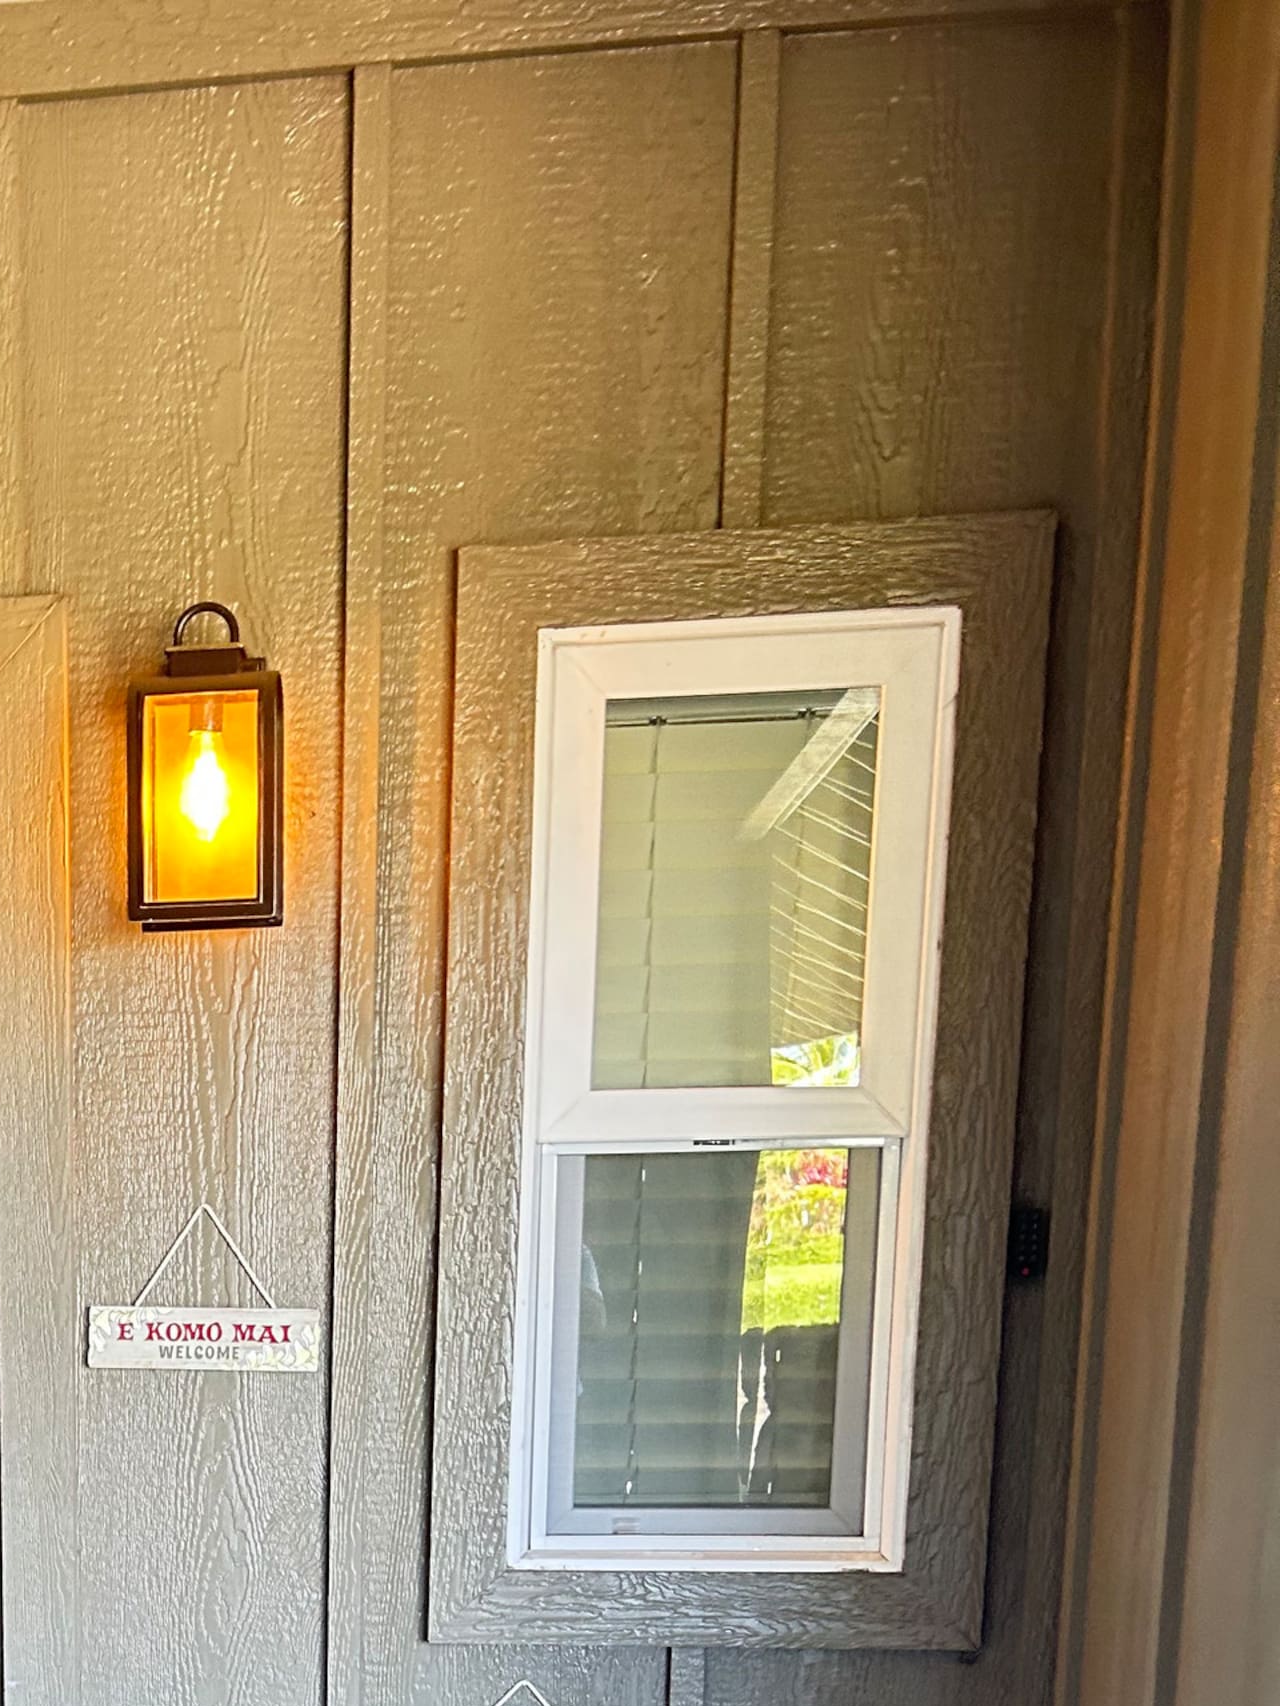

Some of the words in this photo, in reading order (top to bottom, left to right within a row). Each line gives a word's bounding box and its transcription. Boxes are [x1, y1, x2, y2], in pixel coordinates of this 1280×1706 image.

[117, 1322, 134, 1341] E
[144, 1322, 223, 1342] KOMO
[232, 1323, 293, 1344] MAI
[159, 1345, 240, 1360] WELCOME
